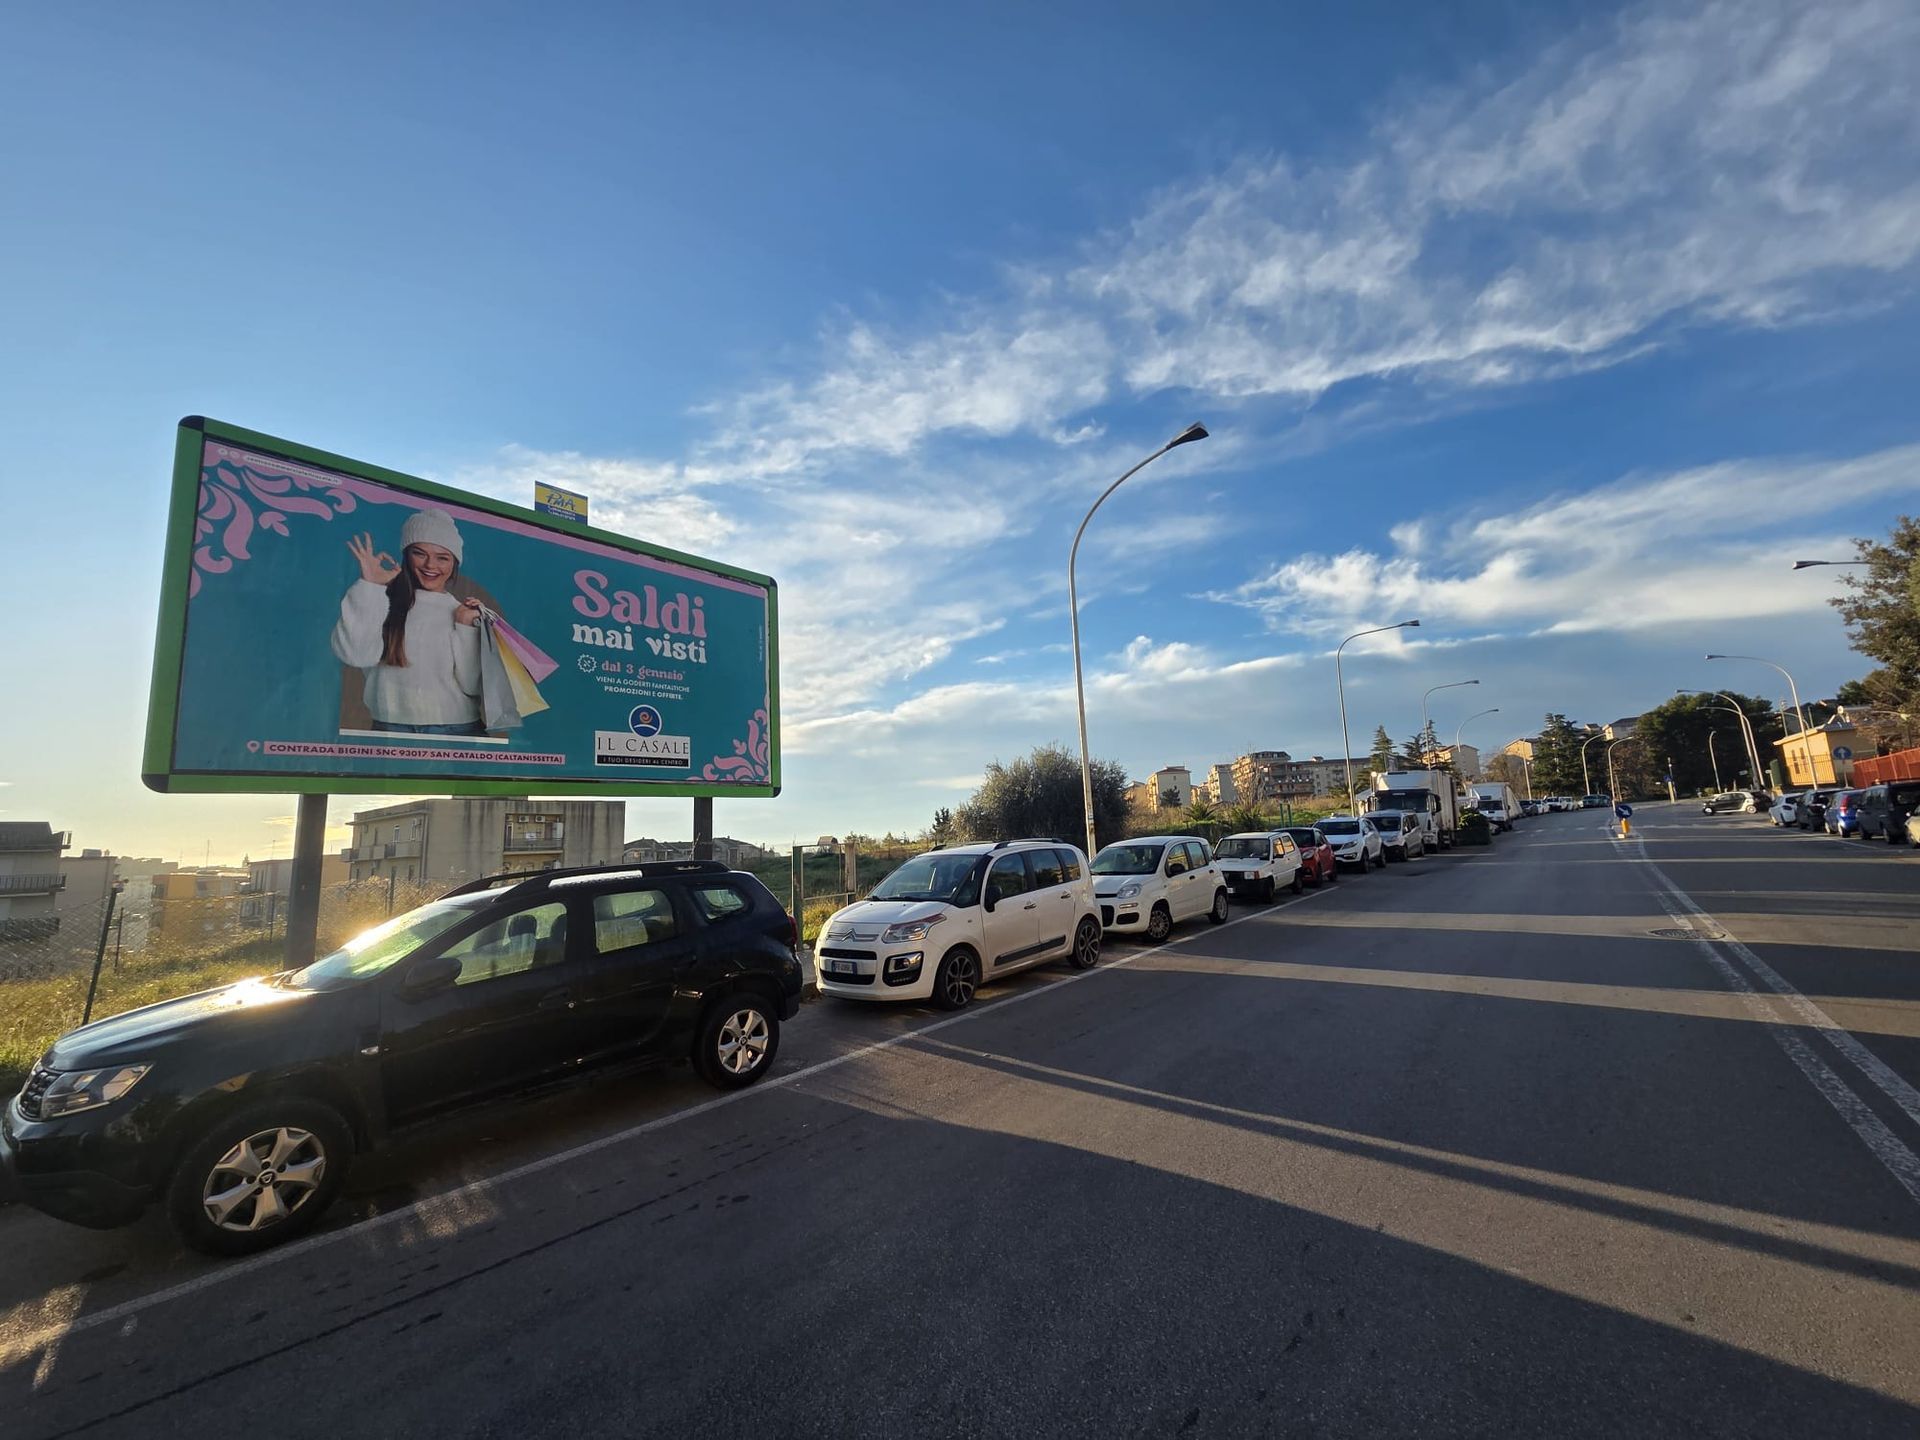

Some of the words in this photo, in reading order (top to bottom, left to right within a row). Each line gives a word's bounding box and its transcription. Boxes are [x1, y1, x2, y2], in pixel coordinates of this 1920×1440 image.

[572, 569, 707, 638] Saldi
[572, 623, 634, 651] mai
[645, 633, 707, 664] visti
[601, 660, 621, 673] dal
[626, 663, 634, 674] 3
[596, 676, 615, 684] VIENI
[623, 678, 651, 688] GODERTI
[652, 682, 690, 693] FANTASTICHE
[604, 686, 651, 697] PROMOZIONI
[269, 744, 335, 754] CONTRADA
[338, 747, 373, 755] BIGINI
[376, 748, 397, 756] SNC
[399, 750, 428, 758] 93017
[453, 752, 493, 760] CATALDO
[495, 753, 563, 764] (CALTANISSETTA)
[597, 736, 615, 751] IL
[625, 738, 689, 755] CASALE
